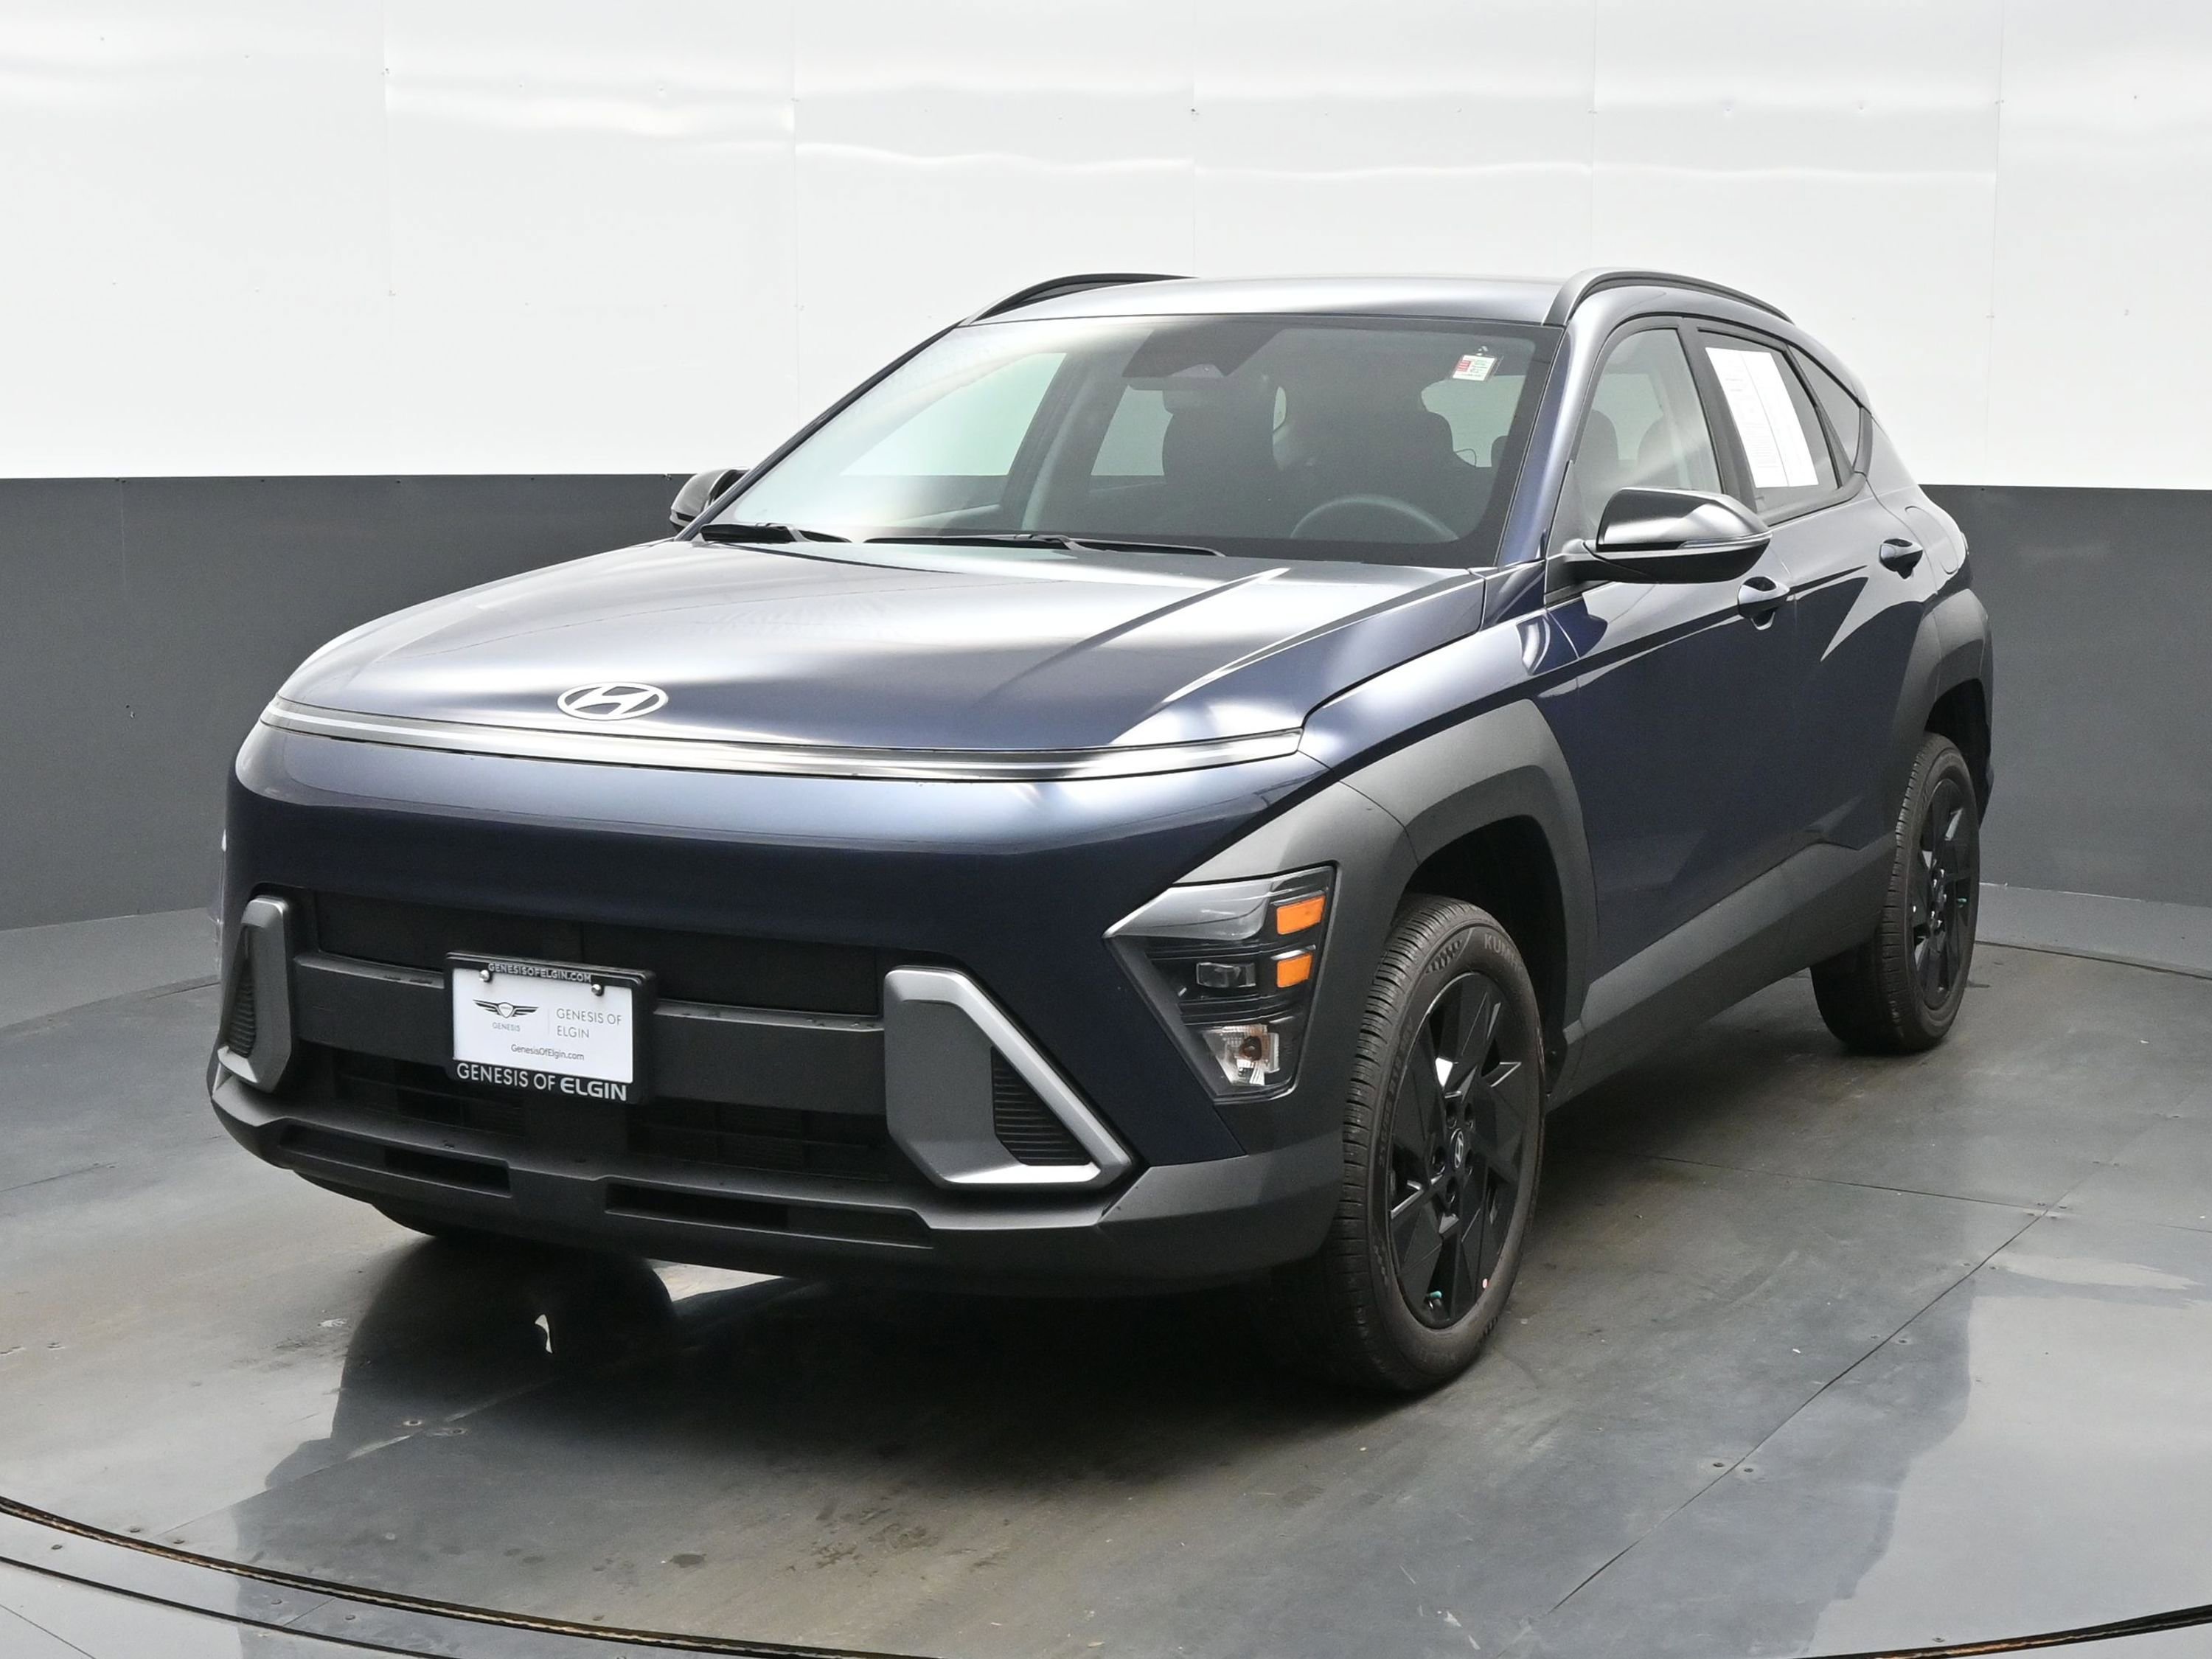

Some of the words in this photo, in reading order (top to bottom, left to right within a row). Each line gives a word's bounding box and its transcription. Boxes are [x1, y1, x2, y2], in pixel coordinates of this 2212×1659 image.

[487, 962, 591, 983] GENESISOFELGIN.COM
[556, 1008, 603, 1023] GENESIS
[607, 1013, 622, 1026] OF
[492, 1021, 521, 1032] GENESIS
[557, 1025, 590, 1038] ELGIN
[510, 1043, 585, 1061] GenesisOfElgin.com
[456, 1062, 529, 1087] GENESIS
[533, 1073, 555, 1091] OF
[560, 1077, 627, 1102] ELGIN
